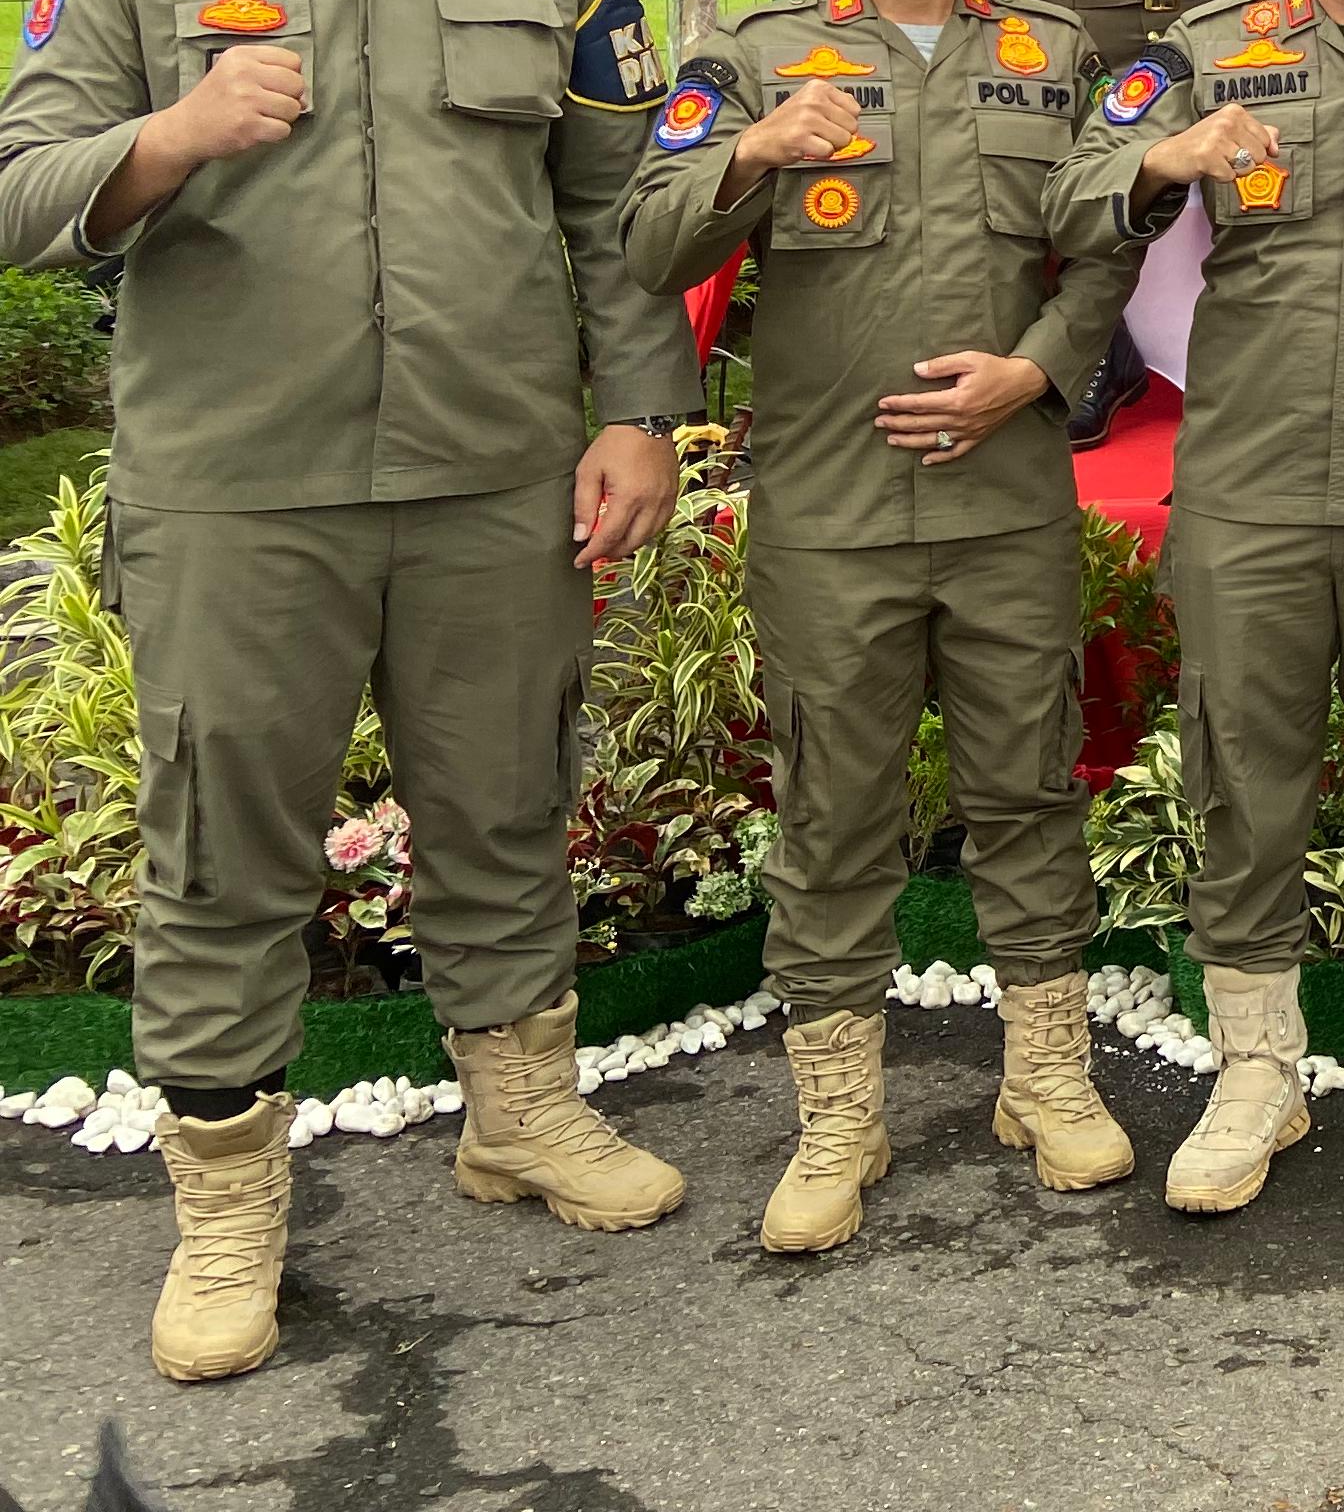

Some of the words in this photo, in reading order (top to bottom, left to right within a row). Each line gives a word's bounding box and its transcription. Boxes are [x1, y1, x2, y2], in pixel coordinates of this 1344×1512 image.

[977, 81, 1030, 106] POL
[1041, 85, 1071, 110] PP
[1213, 70, 1309, 104] RAKHMAT
